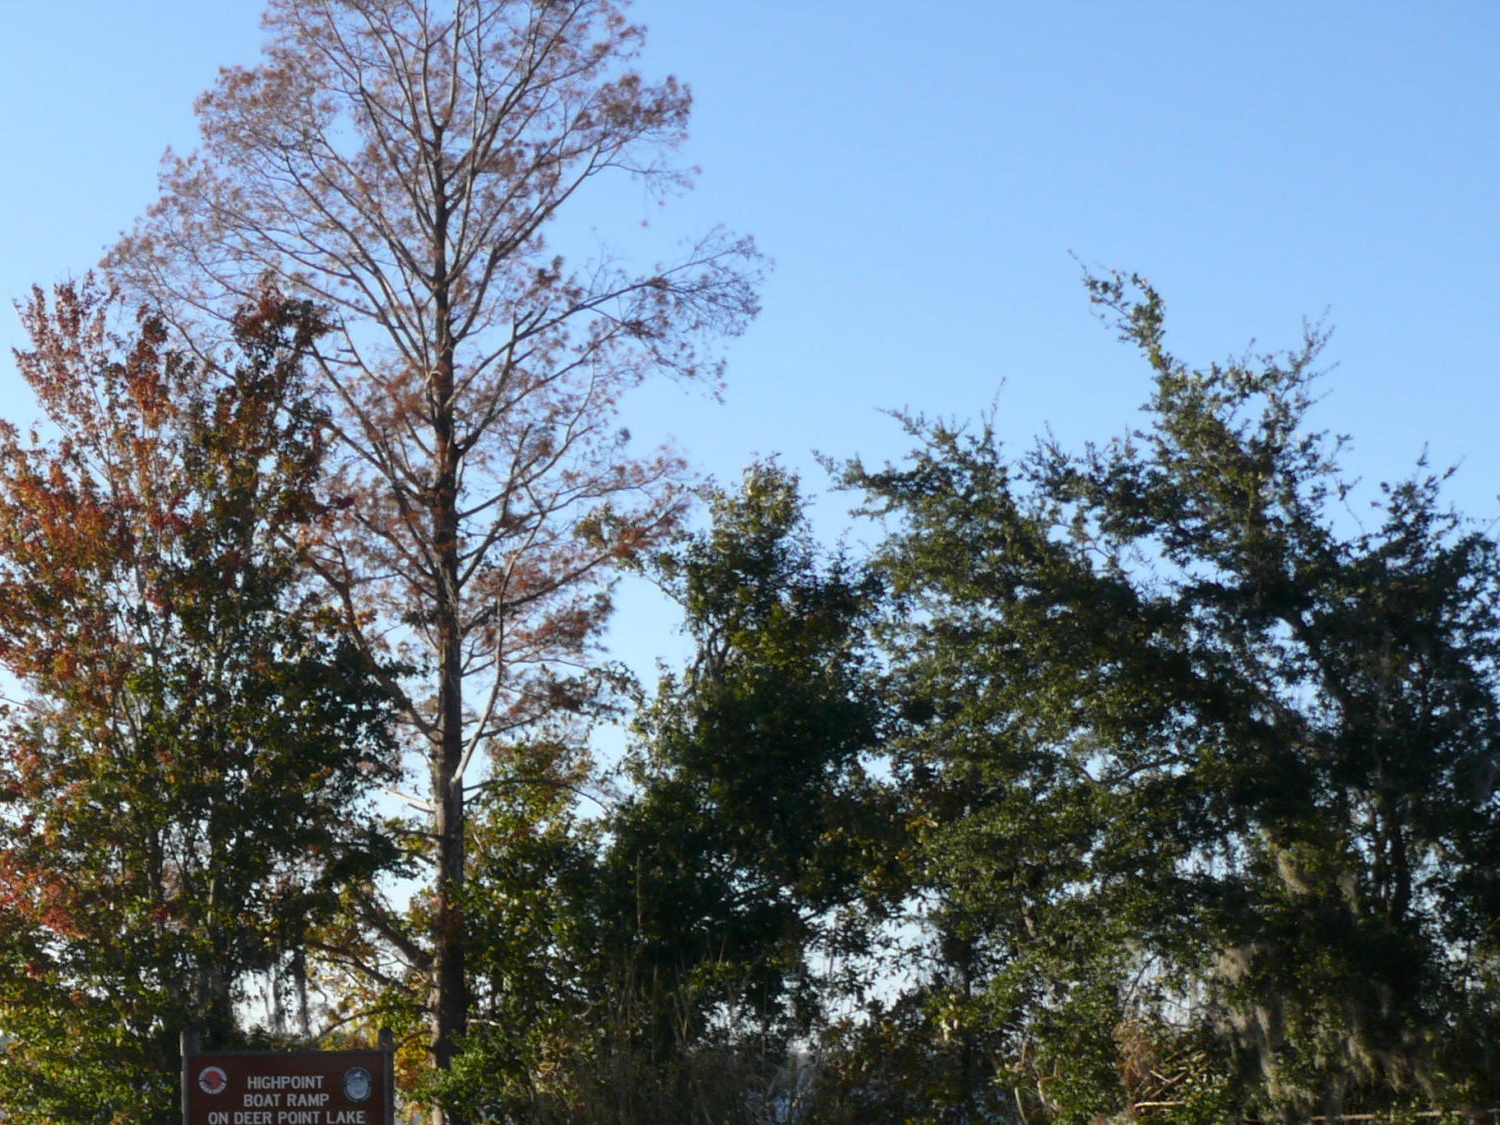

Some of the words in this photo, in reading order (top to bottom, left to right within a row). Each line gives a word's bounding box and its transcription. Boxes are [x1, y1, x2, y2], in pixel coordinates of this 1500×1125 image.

[247, 1075, 325, 1090] HIGHPOINT
[243, 1093, 281, 1108] BOAT
[286, 1093, 330, 1107] RAMP
[208, 1111, 229, 1125] ON
[233, 1111, 273, 1125] DEER
[277, 1111, 321, 1125] POINT
[326, 1110, 367, 1125] LAKE
